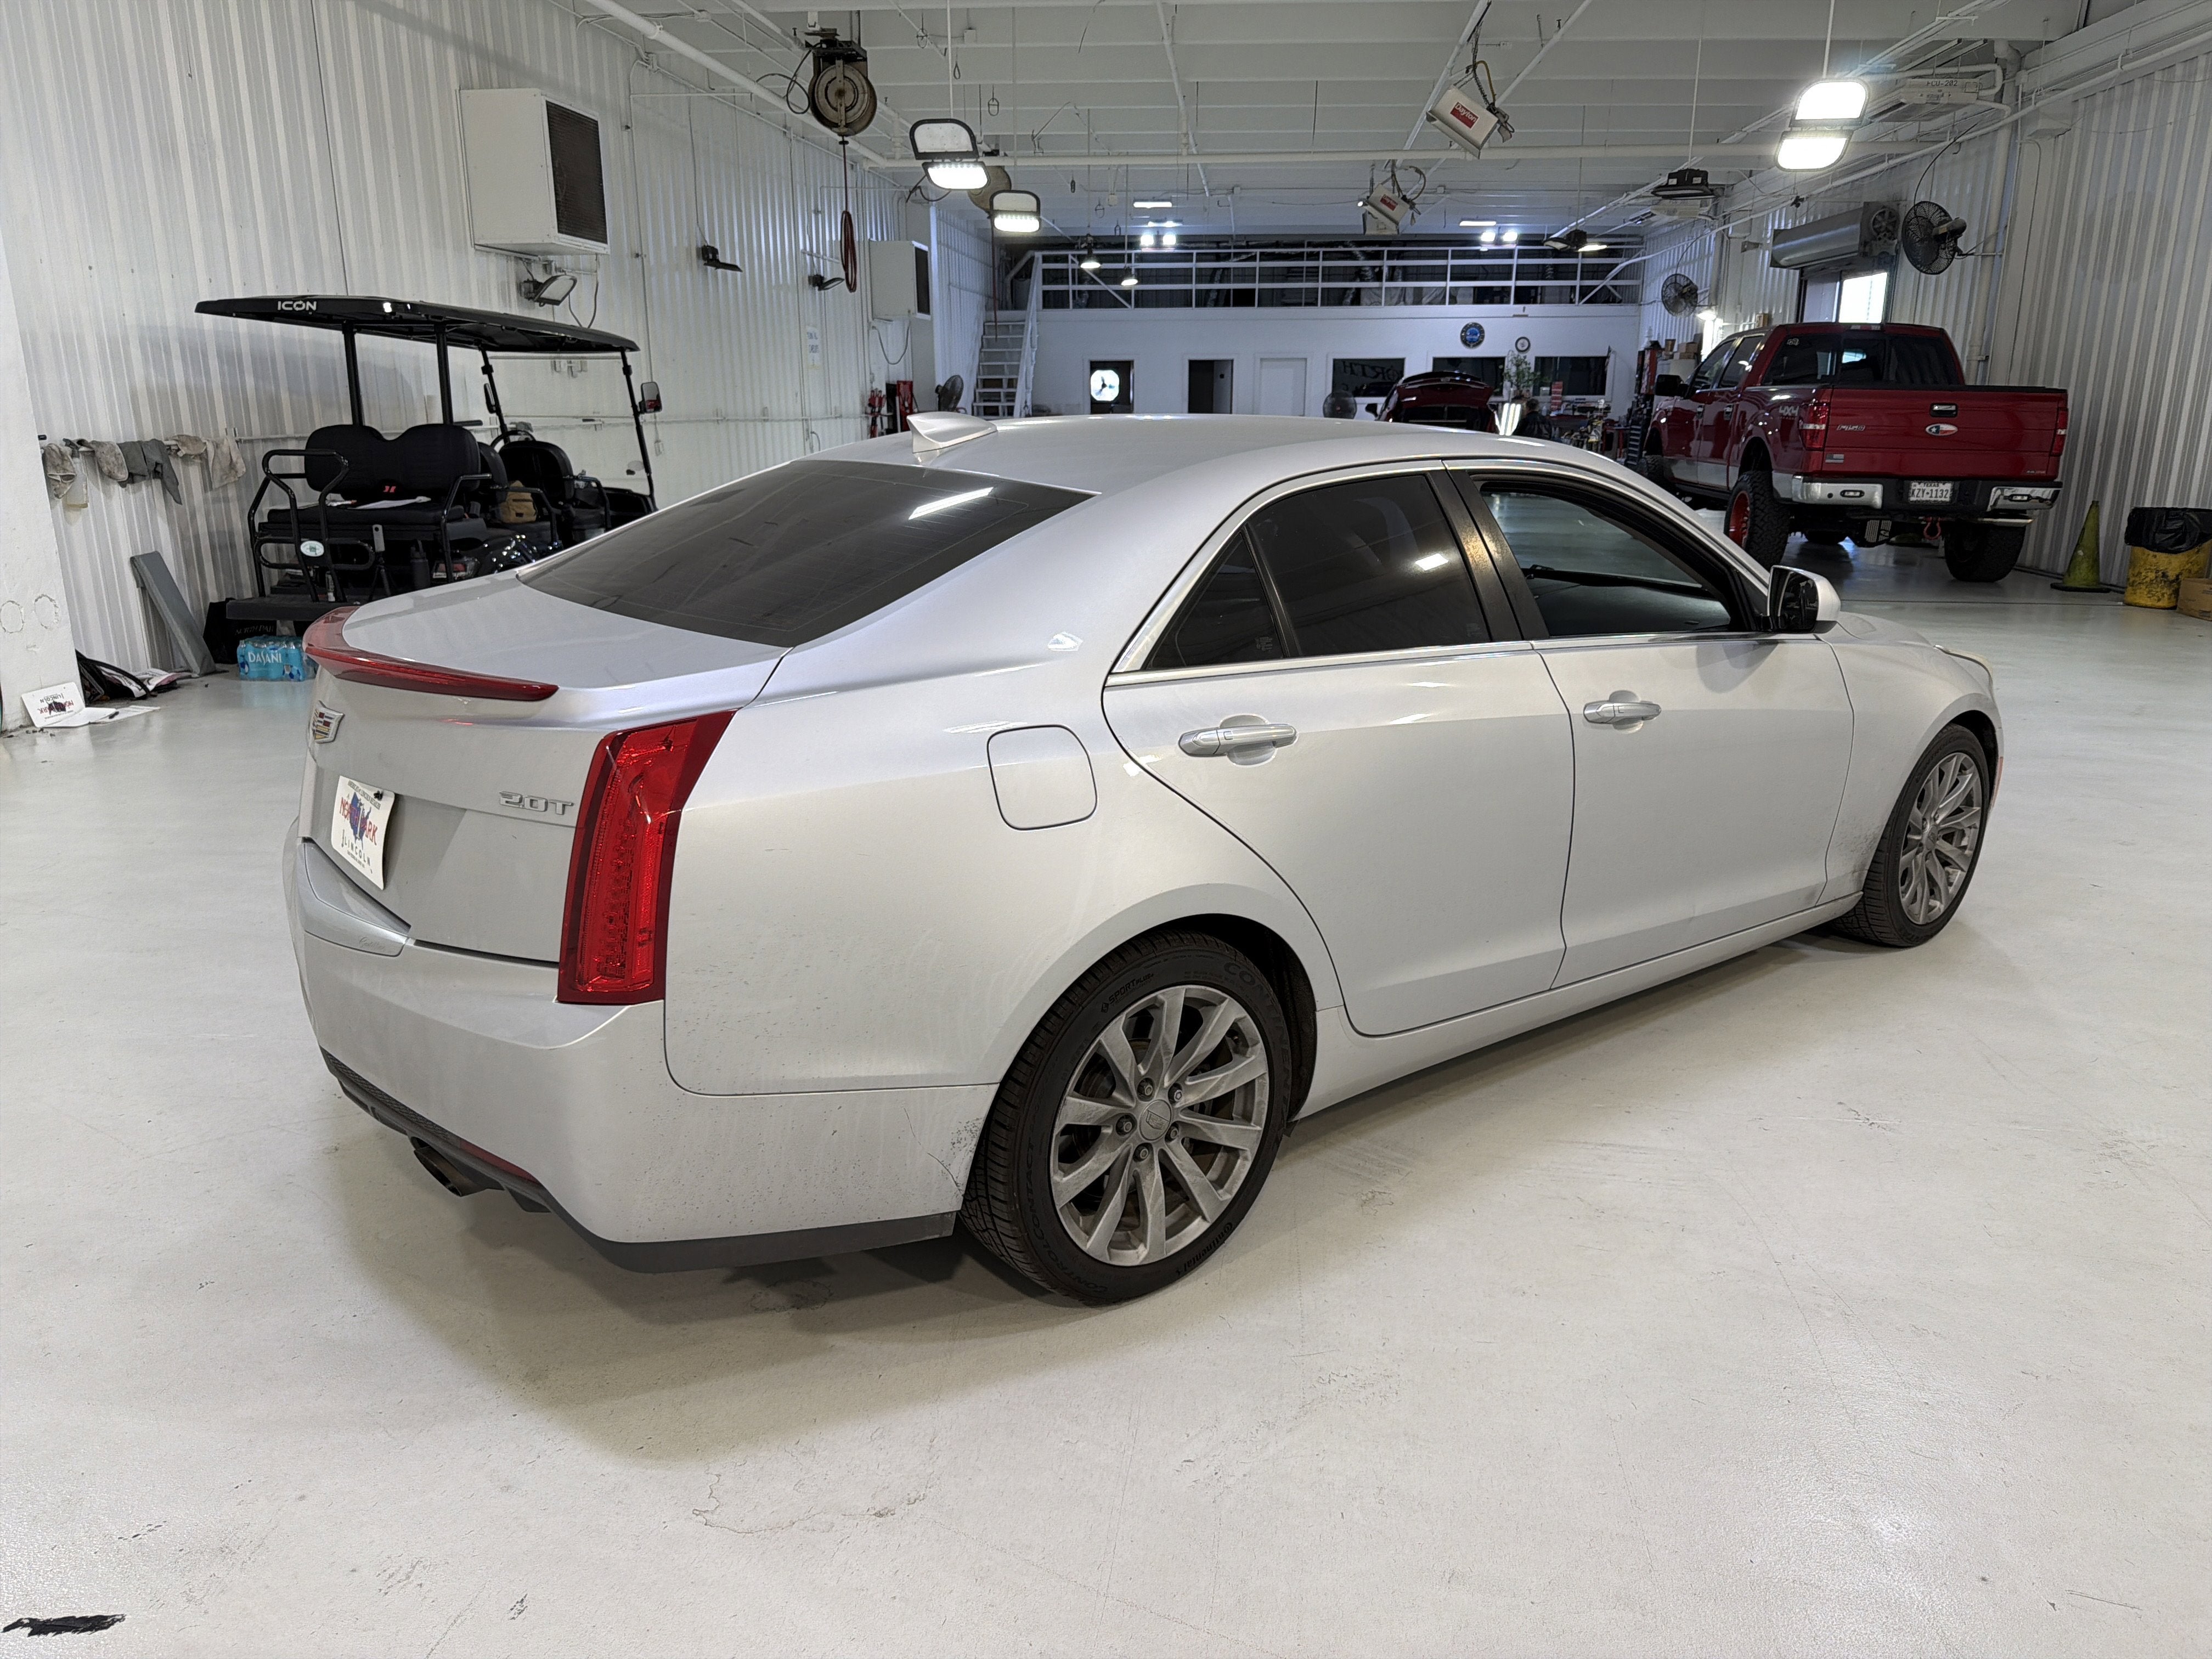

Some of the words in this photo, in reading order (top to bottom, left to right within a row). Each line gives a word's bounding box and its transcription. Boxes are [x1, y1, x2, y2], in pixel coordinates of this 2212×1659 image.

[1454, 103, 1477, 123] Dayton
[278, 300, 317, 311] ICON
[248, 650, 282, 666] DASANI
[499, 791, 574, 816] 2.0T
[340, 797, 360, 827] NORTH
[361, 812, 377, 846] PARK
[345, 836, 372, 867] LINCOLN
[1183, 1221, 1233, 1272] Continental
